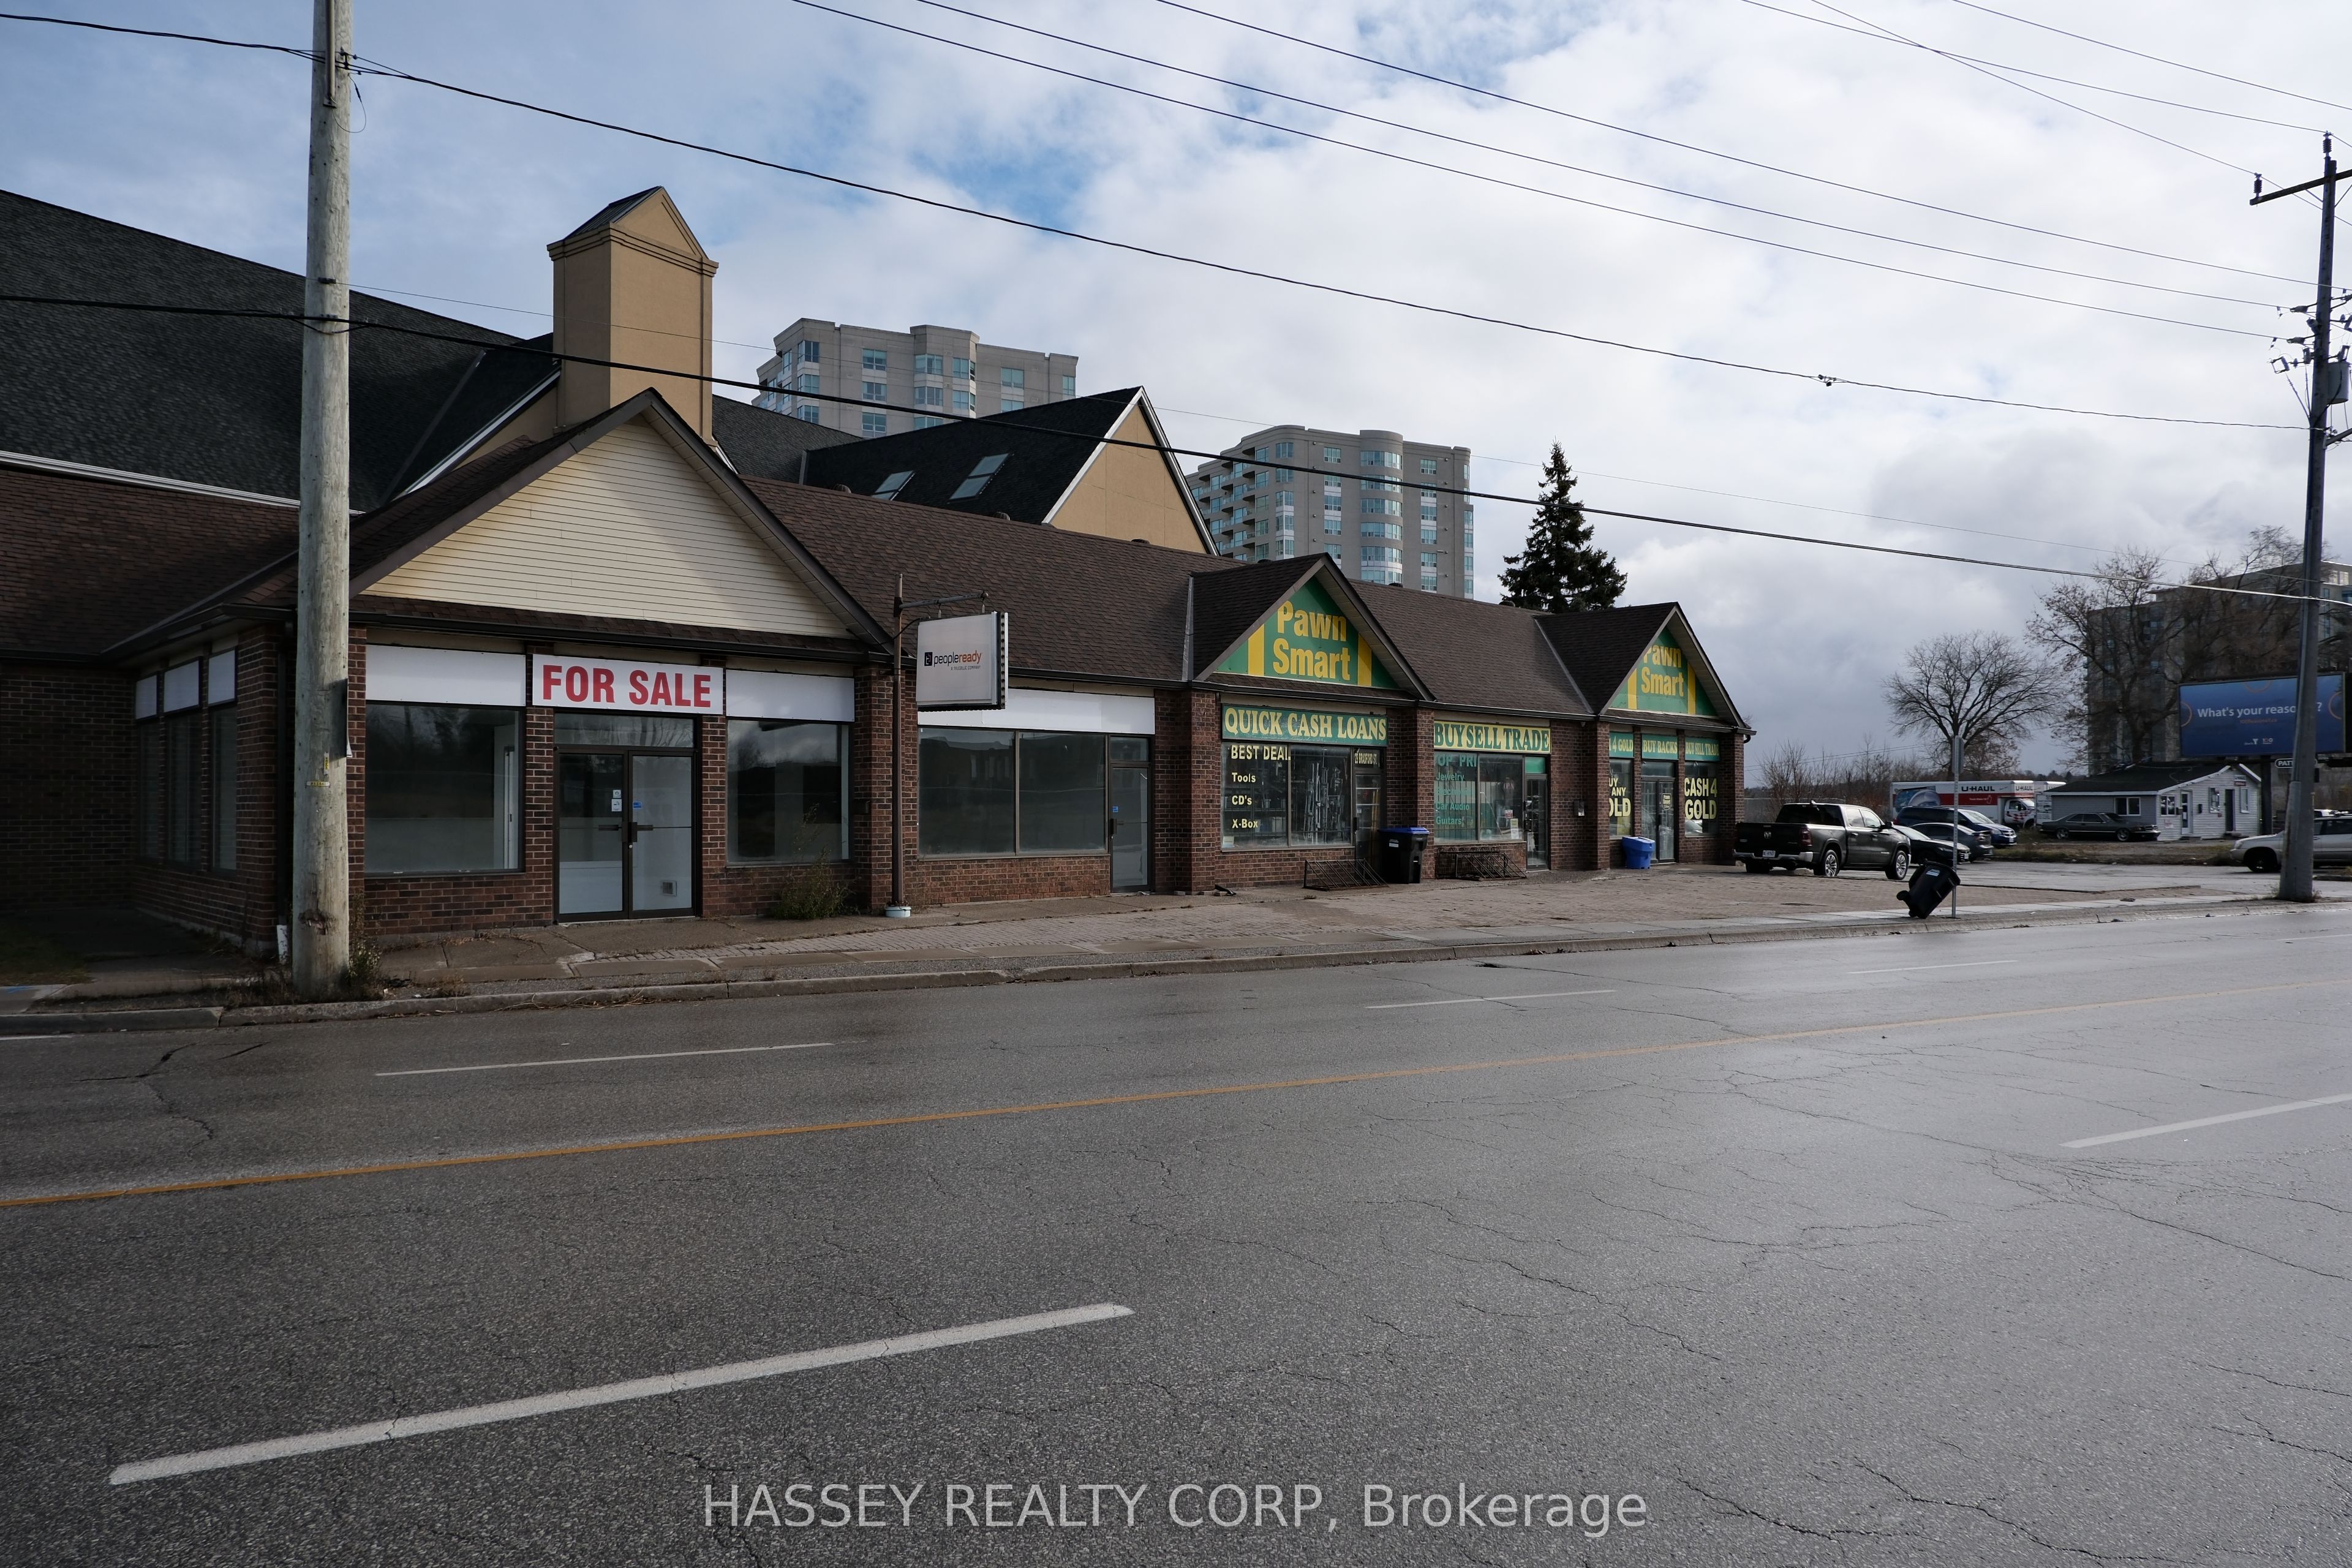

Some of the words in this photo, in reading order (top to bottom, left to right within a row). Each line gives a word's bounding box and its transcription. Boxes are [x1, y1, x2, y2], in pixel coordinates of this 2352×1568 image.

[1278, 600, 1346, 642] Pawn
[934, 650, 981, 668] peopleready
[1273, 638, 1350, 680] Smart
[543, 665, 615, 703] FOR
[629, 669, 710, 707] SALE
[1642, 666, 1684, 696] Smart
[2198, 707, 2234, 717] What's
[2237, 707, 2263, 718] your
[1225, 708, 1283, 735] QUICK
[1287, 713, 1332, 737] CASH
[1338, 716, 1386, 741] LOANS
[1434, 723, 1464, 747] BUY
[1466, 725, 1501, 749] SELL
[1504, 728, 1550, 751] TRADE
[1612, 736, 1616, 753] 4
[1618, 739, 1634, 752] GOLD
[1231, 745, 1259, 760] BEST
[1643, 740, 1656, 753] BUY
[1657, 741, 1678, 754] BACKS
[1686, 742, 1694, 755] BUY
[1695, 742, 1705, 755] SELL
[1705, 743, 1719, 755] TRADE
[1232, 772, 1256, 782] Tools
[1436, 773, 1464, 782] Jewelry
[1609, 778, 1618, 787] UY
[1611, 787, 1626, 796] ANY
[1684, 777, 1709, 797] CASH
[1710, 778, 1717, 797] 4
[1232, 796, 1252, 805] CD's
[1609, 798, 1631, 816] OLD
[1685, 799, 1717, 820] GOLD
[1232, 819, 1259, 828] X-Box
